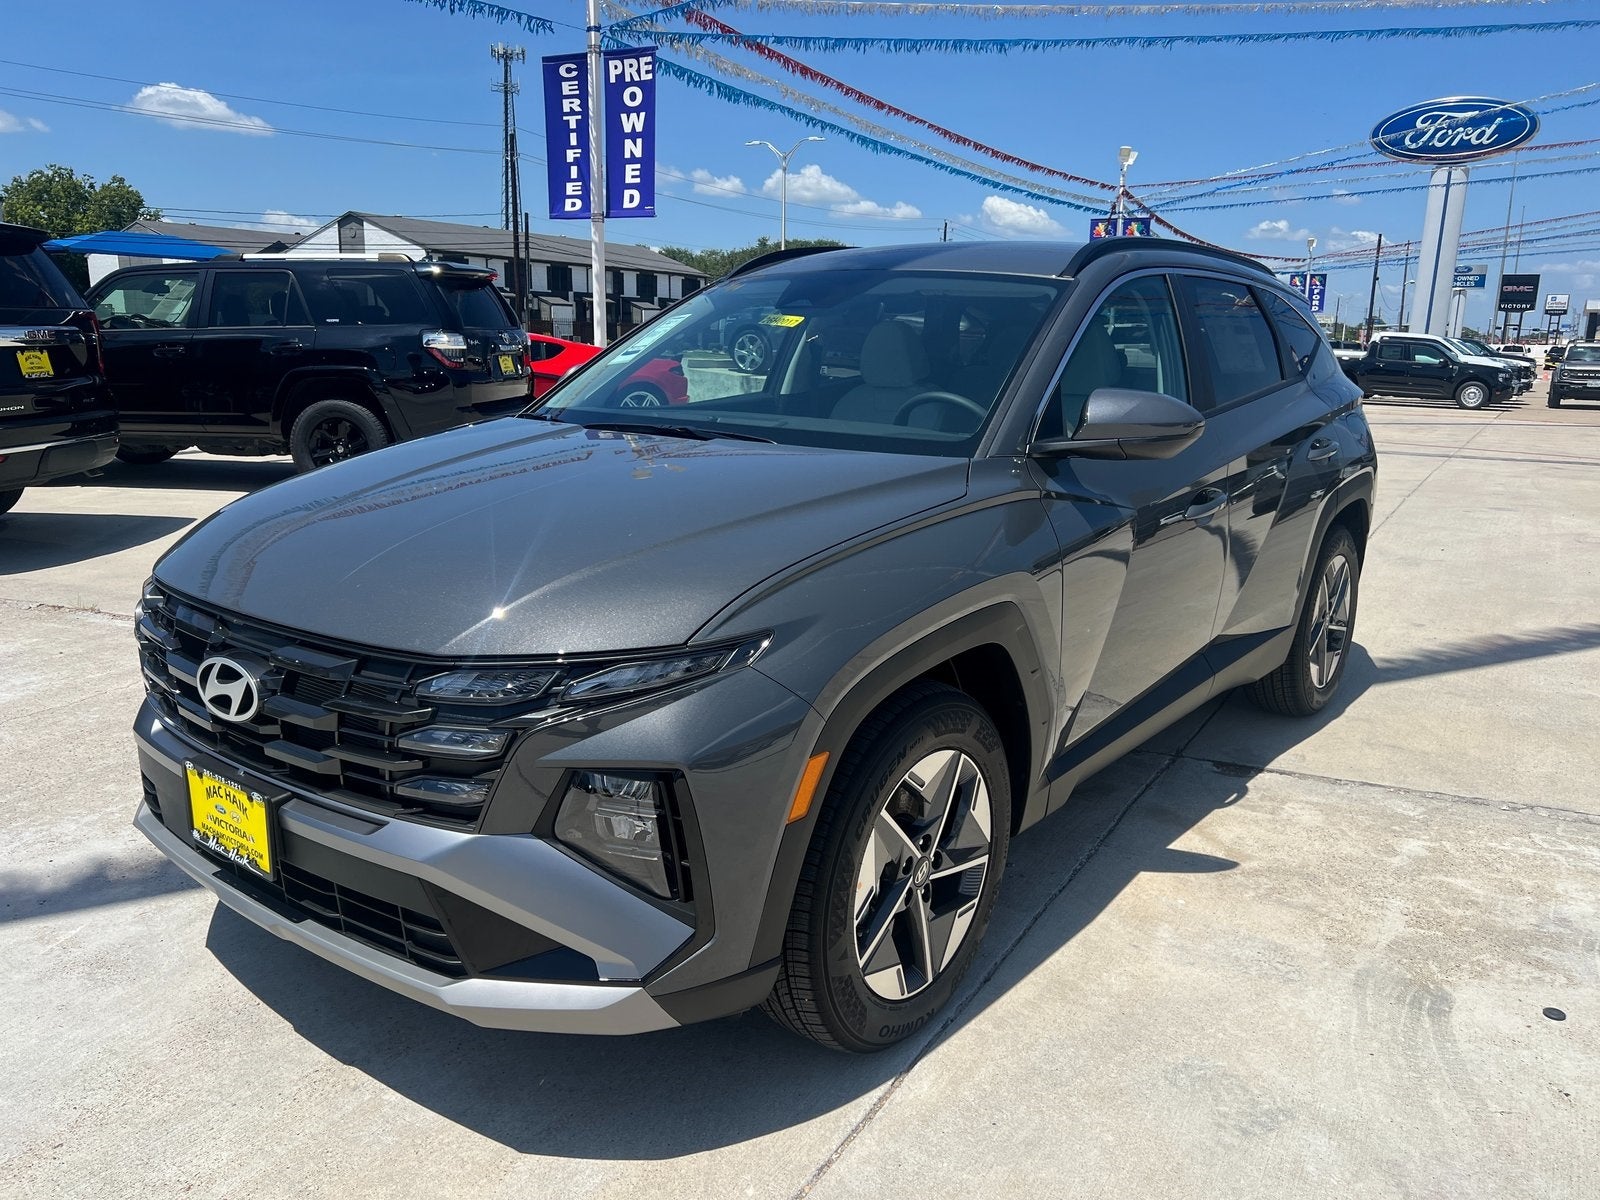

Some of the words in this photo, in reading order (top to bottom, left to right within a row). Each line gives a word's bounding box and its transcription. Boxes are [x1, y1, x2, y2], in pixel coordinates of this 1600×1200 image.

[608, 56, 653, 84] PRE
[558, 63, 583, 212] CERTIFIED
[1404, 110, 1503, 149] Ford
[620, 86, 646, 209] OWNED
[205, 785, 223, 800] MAC
[212, 814, 248, 841] VICTORIA
[878, 1007, 937, 1038] KUMHO
